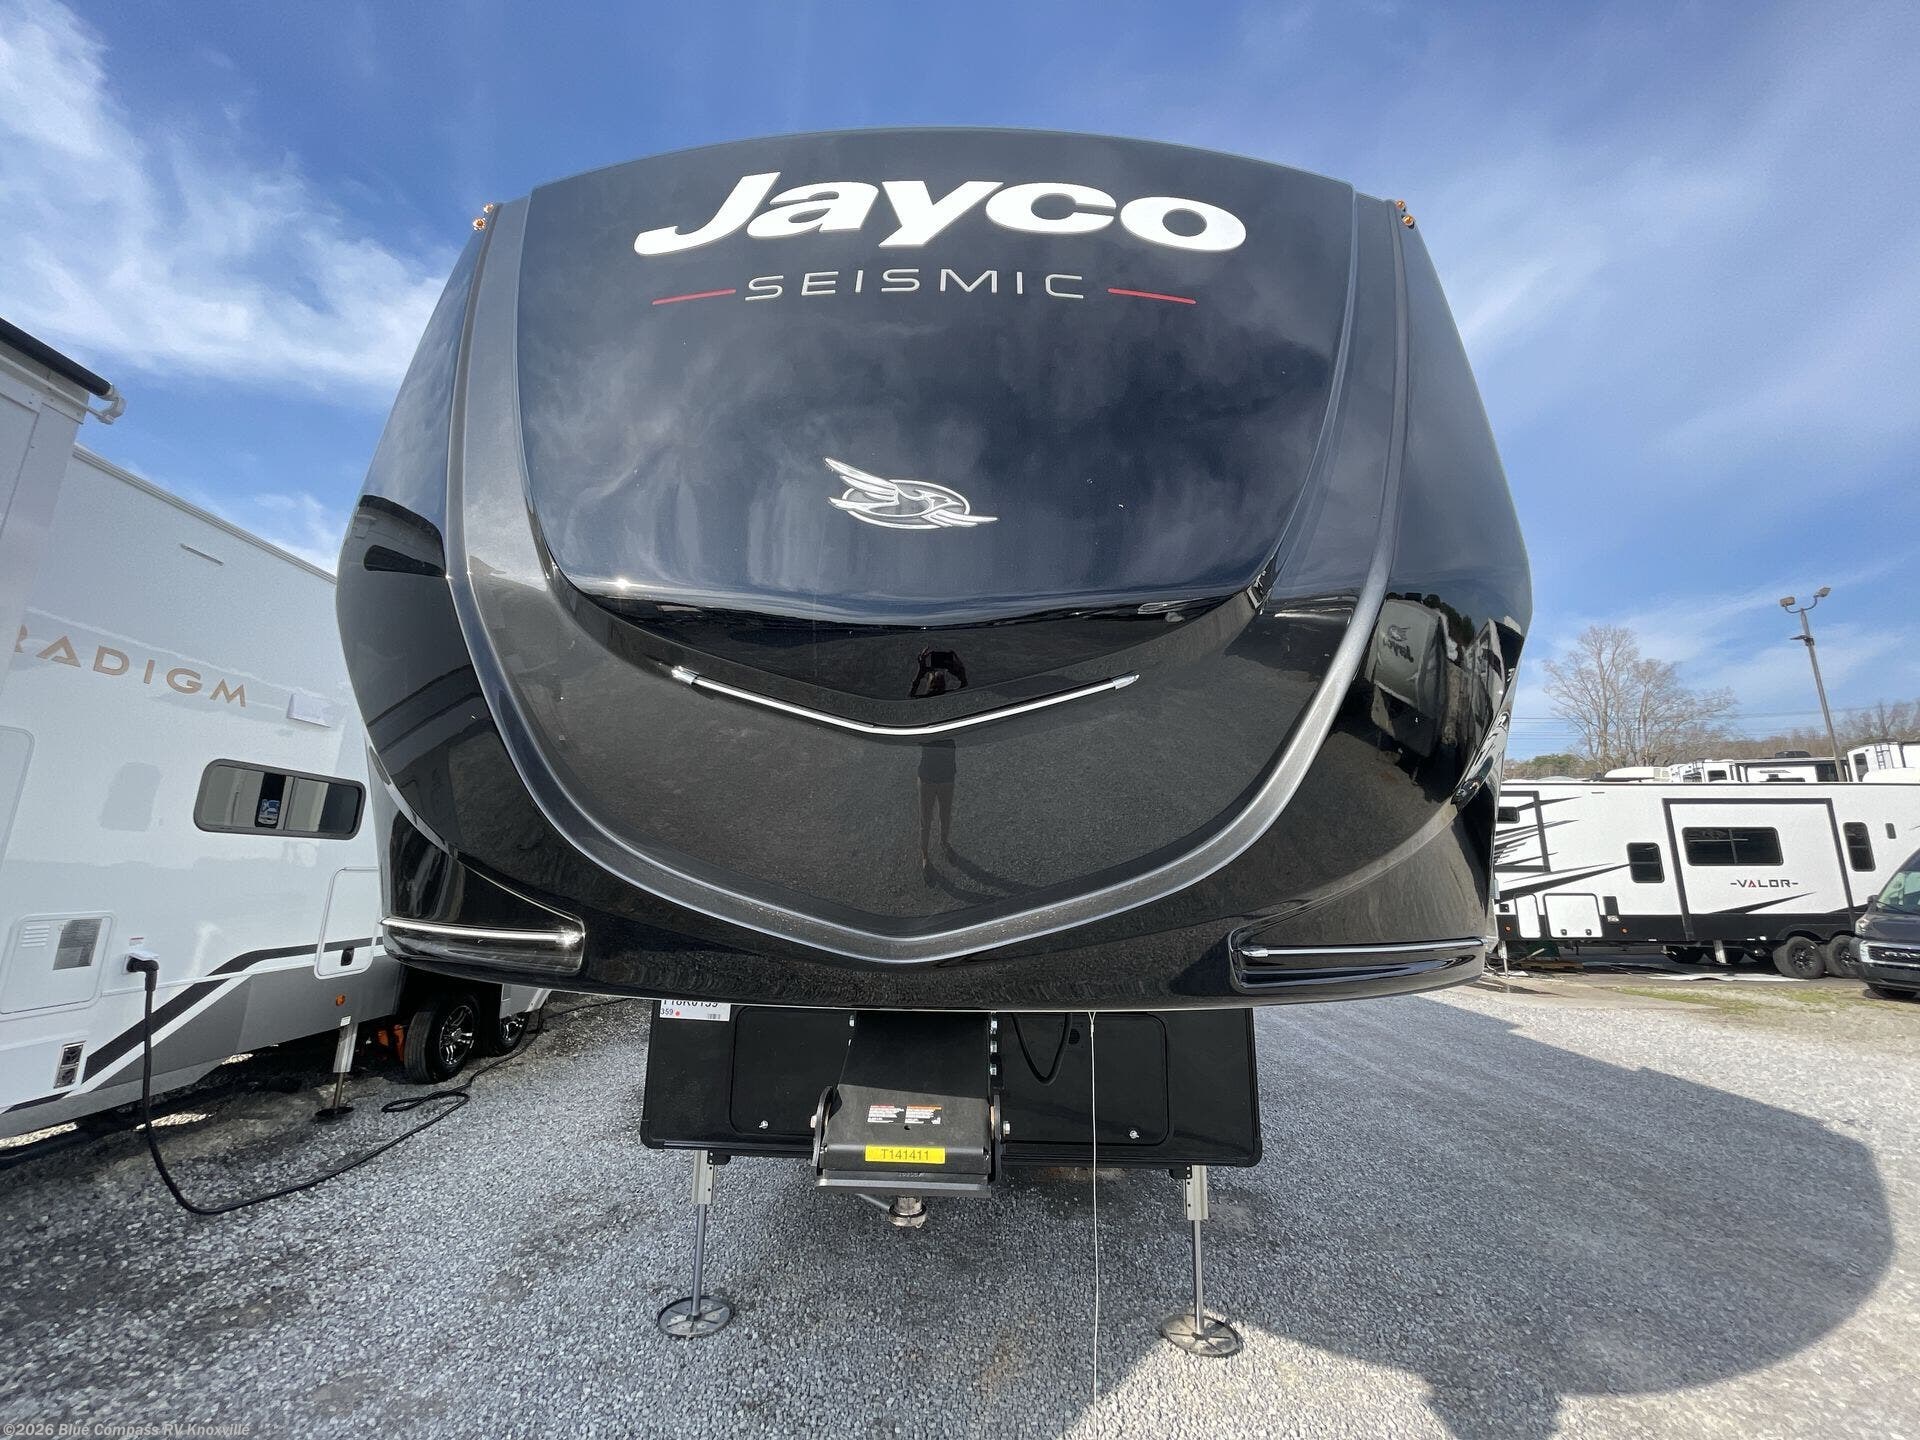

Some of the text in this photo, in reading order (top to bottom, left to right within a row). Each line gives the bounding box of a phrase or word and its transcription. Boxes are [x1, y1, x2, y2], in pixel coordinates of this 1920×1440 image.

[634, 171, 1246, 256] Jayco
[744, 268, 1086, 301] SEISMIC
[881, 1148, 929, 1161] T141411
